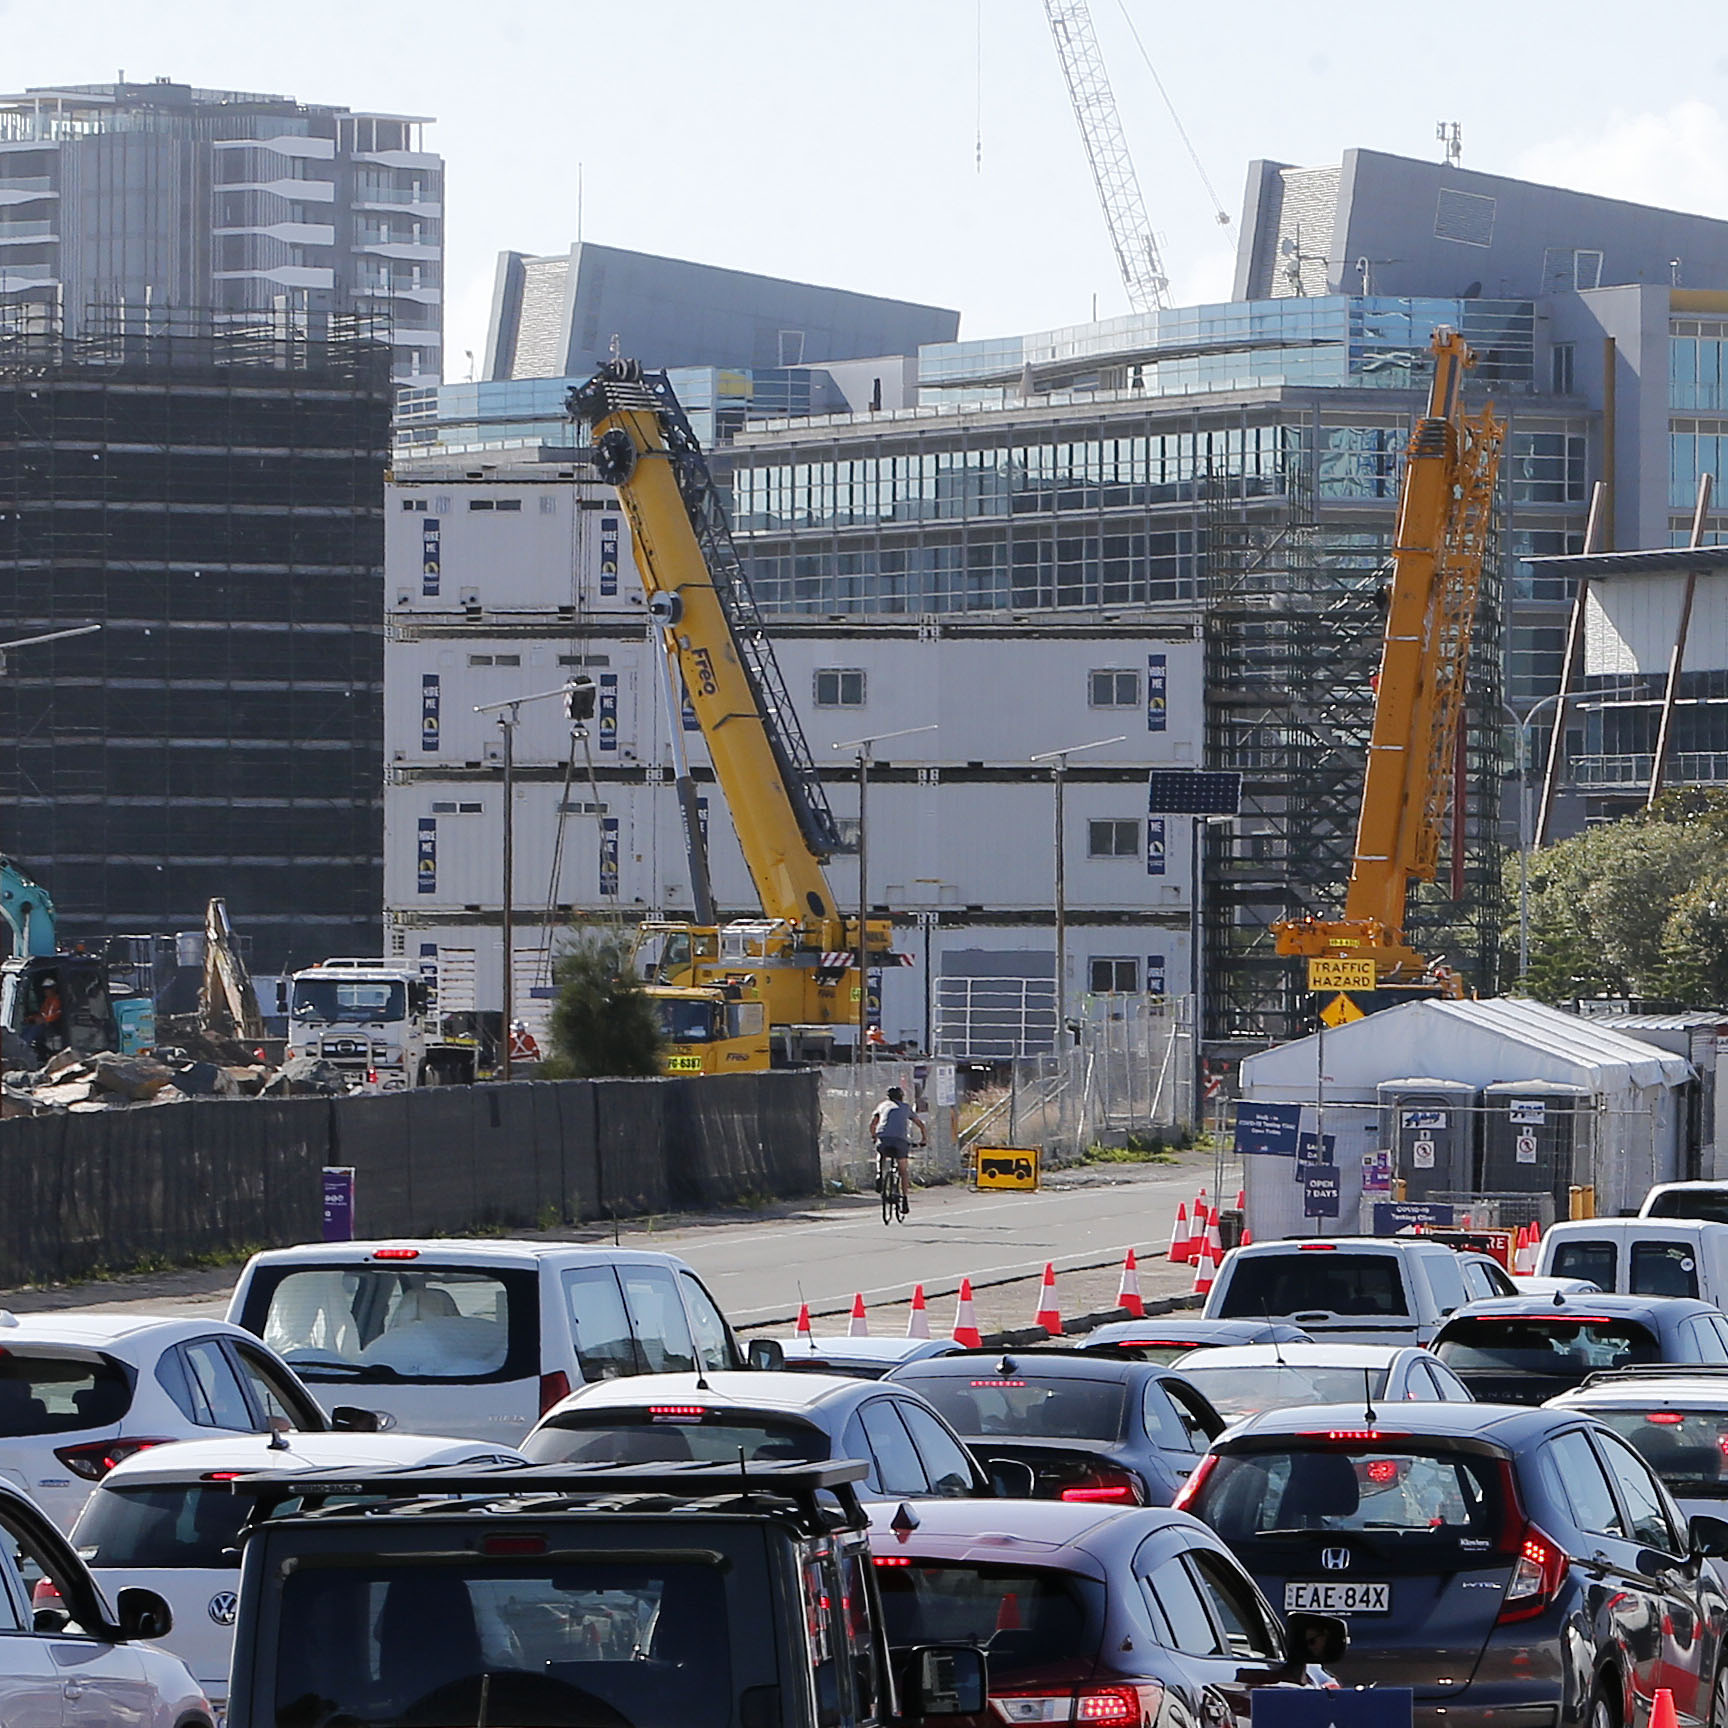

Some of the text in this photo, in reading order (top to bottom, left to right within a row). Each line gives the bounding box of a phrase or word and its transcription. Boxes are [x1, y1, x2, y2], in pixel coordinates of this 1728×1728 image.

[1315, 963, 1370, 973] TRAFFIC
[1314, 977, 1370, 987] HAZARD
[1310, 1180, 1334, 1188] OPEN
[1306, 1190, 1338, 1198] 7 DAYS
[1391, 1213, 1416, 1222] Testing
